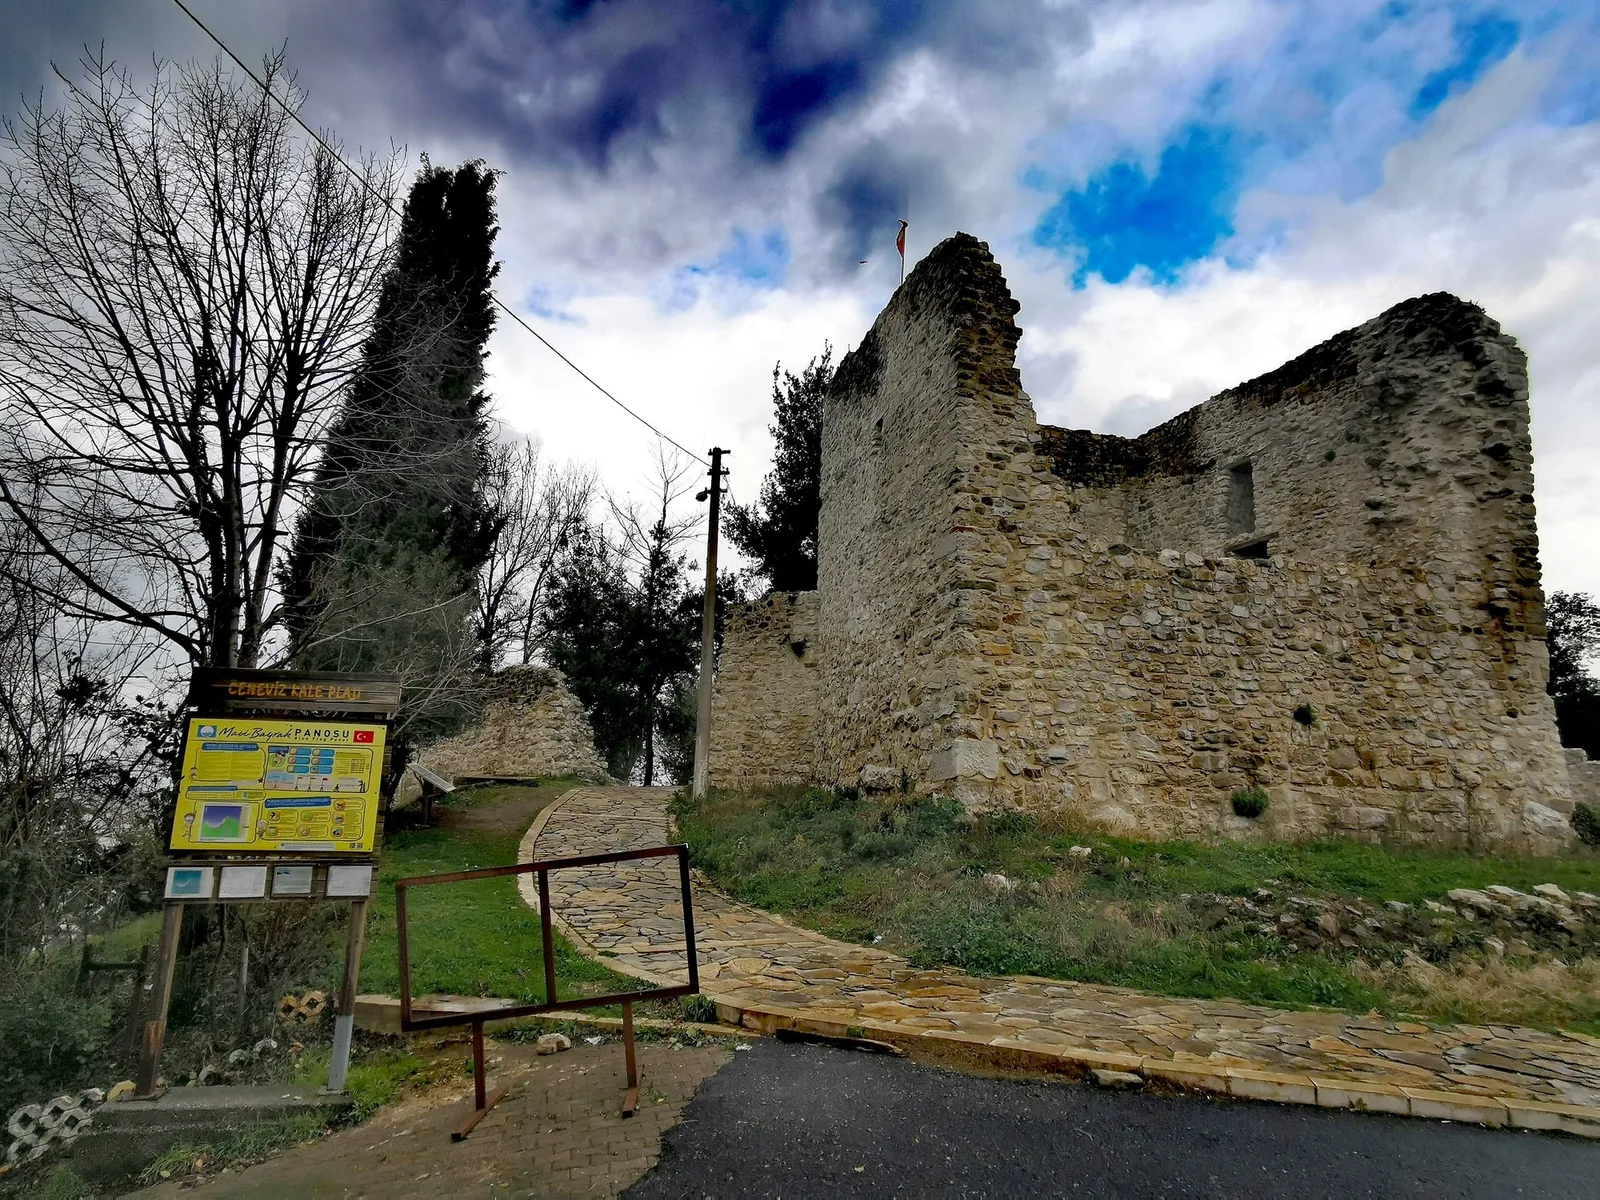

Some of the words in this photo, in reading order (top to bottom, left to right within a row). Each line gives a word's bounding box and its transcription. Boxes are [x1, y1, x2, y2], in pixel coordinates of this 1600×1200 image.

[219, 726, 250, 738] Mavi
[250, 727, 293, 741] Bayrak
[294, 728, 350, 738] PANOSU
